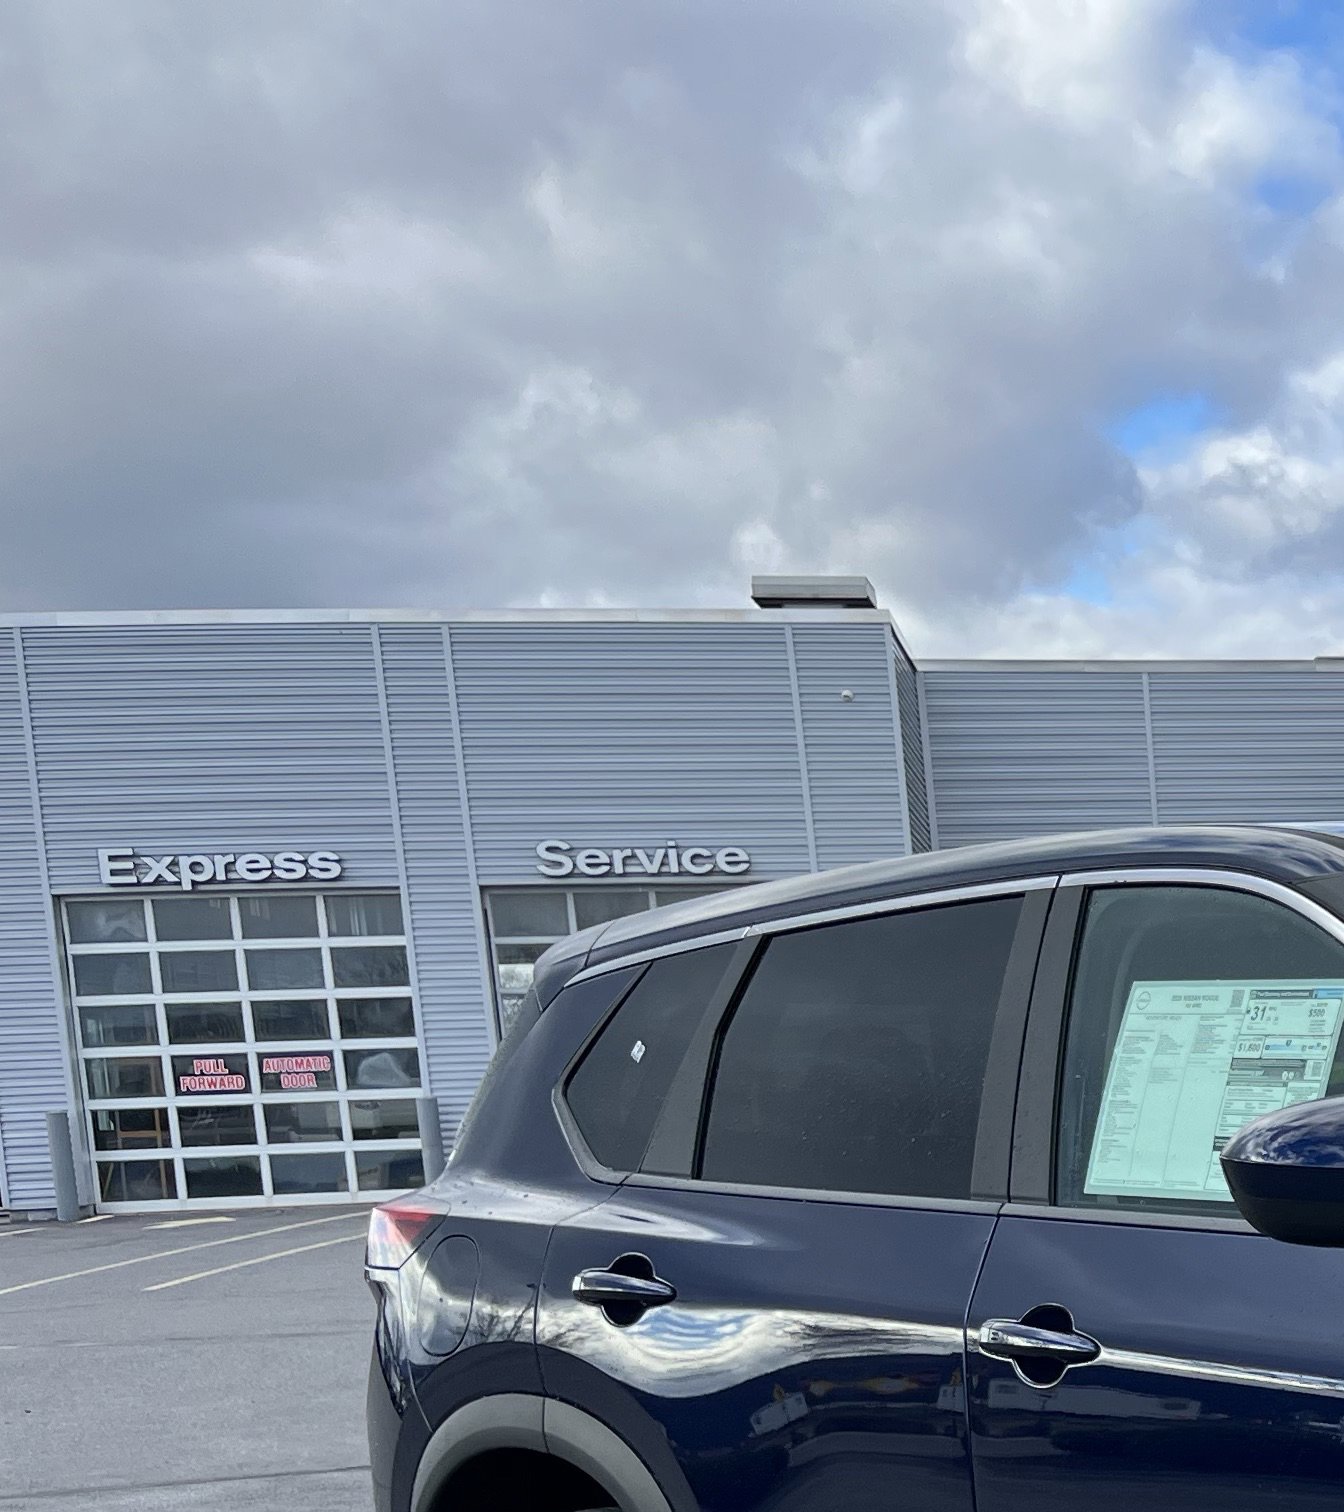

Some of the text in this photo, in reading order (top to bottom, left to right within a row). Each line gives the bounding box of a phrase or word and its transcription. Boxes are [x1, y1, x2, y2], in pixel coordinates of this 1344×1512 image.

[535, 839, 751, 878] Service
[98, 847, 343, 891] Express
[193, 1058, 229, 1075] PULL
[262, 1055, 331, 1074] AUTOMATIC
[180, 1074, 246, 1092] FORWARD
[280, 1073, 317, 1089] DOOR
